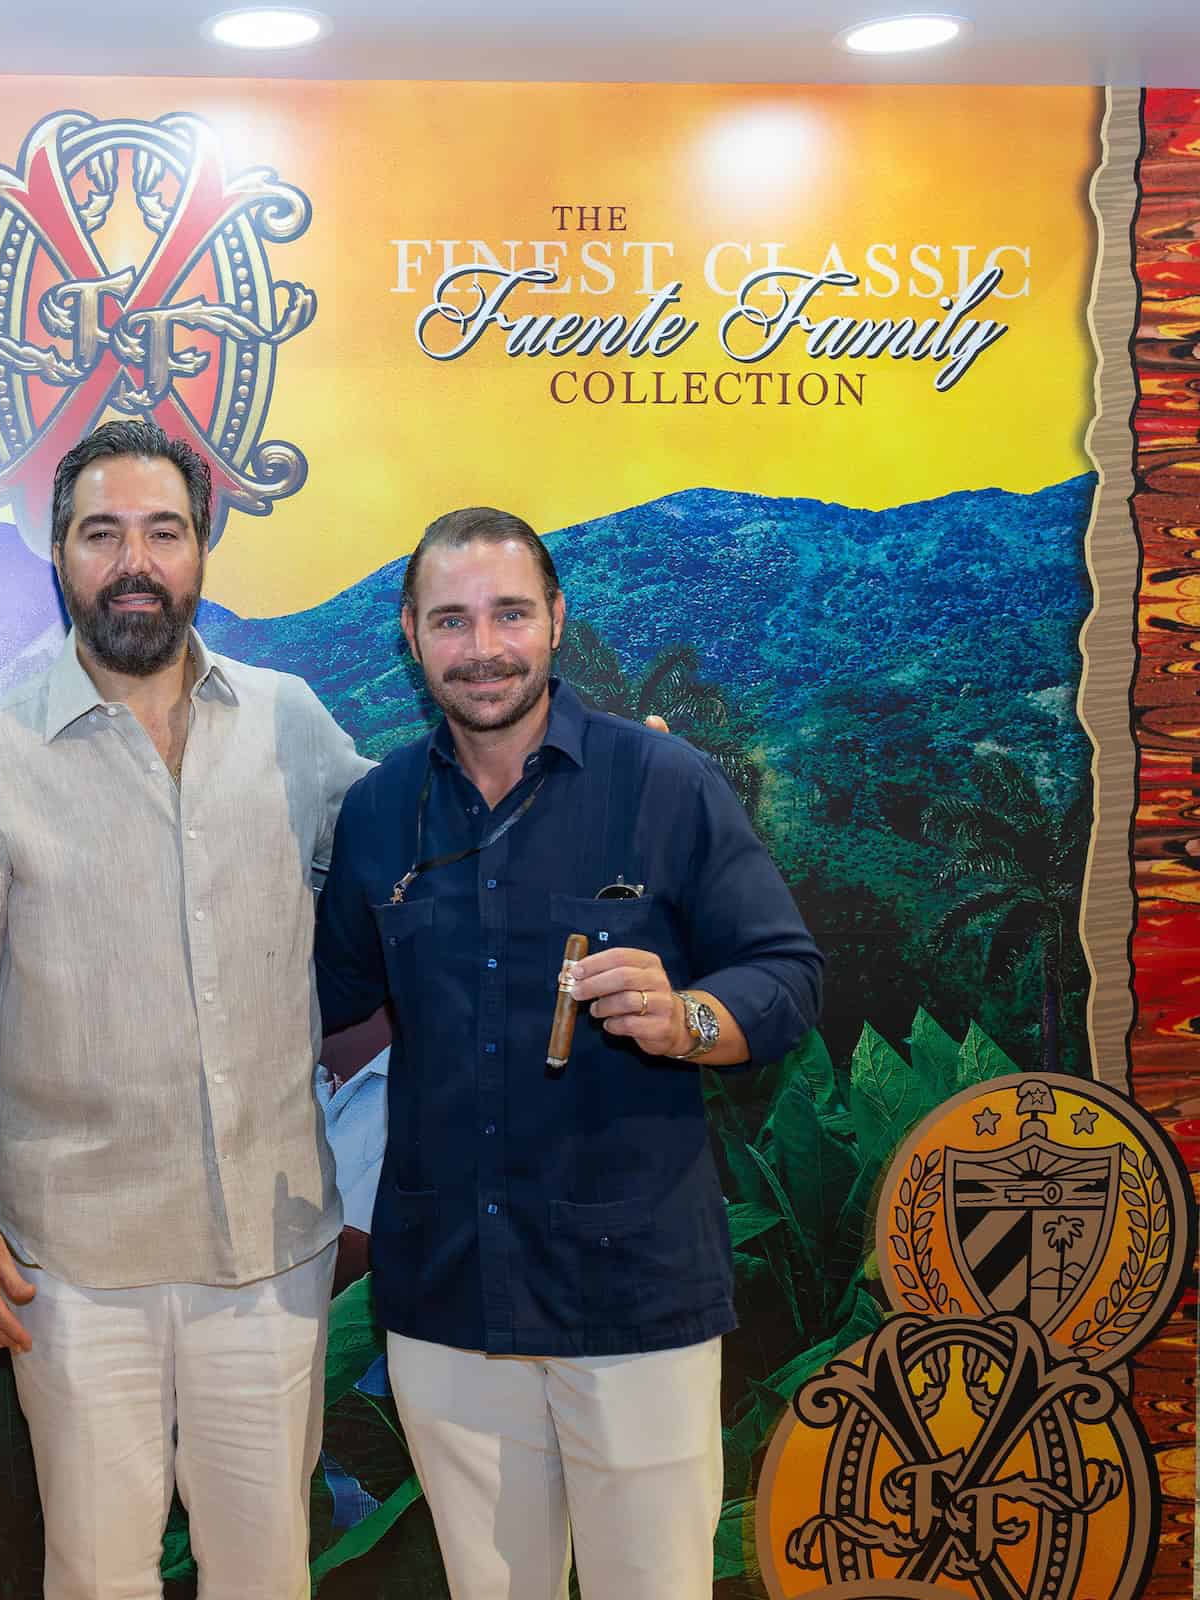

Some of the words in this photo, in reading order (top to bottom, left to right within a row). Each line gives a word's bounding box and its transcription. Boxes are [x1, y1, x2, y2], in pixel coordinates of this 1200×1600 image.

[552, 205, 627, 231] THE
[390, 239, 674, 296] FINEST
[703, 242, 1033, 299] CLASSIC
[414, 264, 698, 361] Fuente
[718, 266, 1008, 391] Family
[550, 371, 866, 406] COLLECTION
